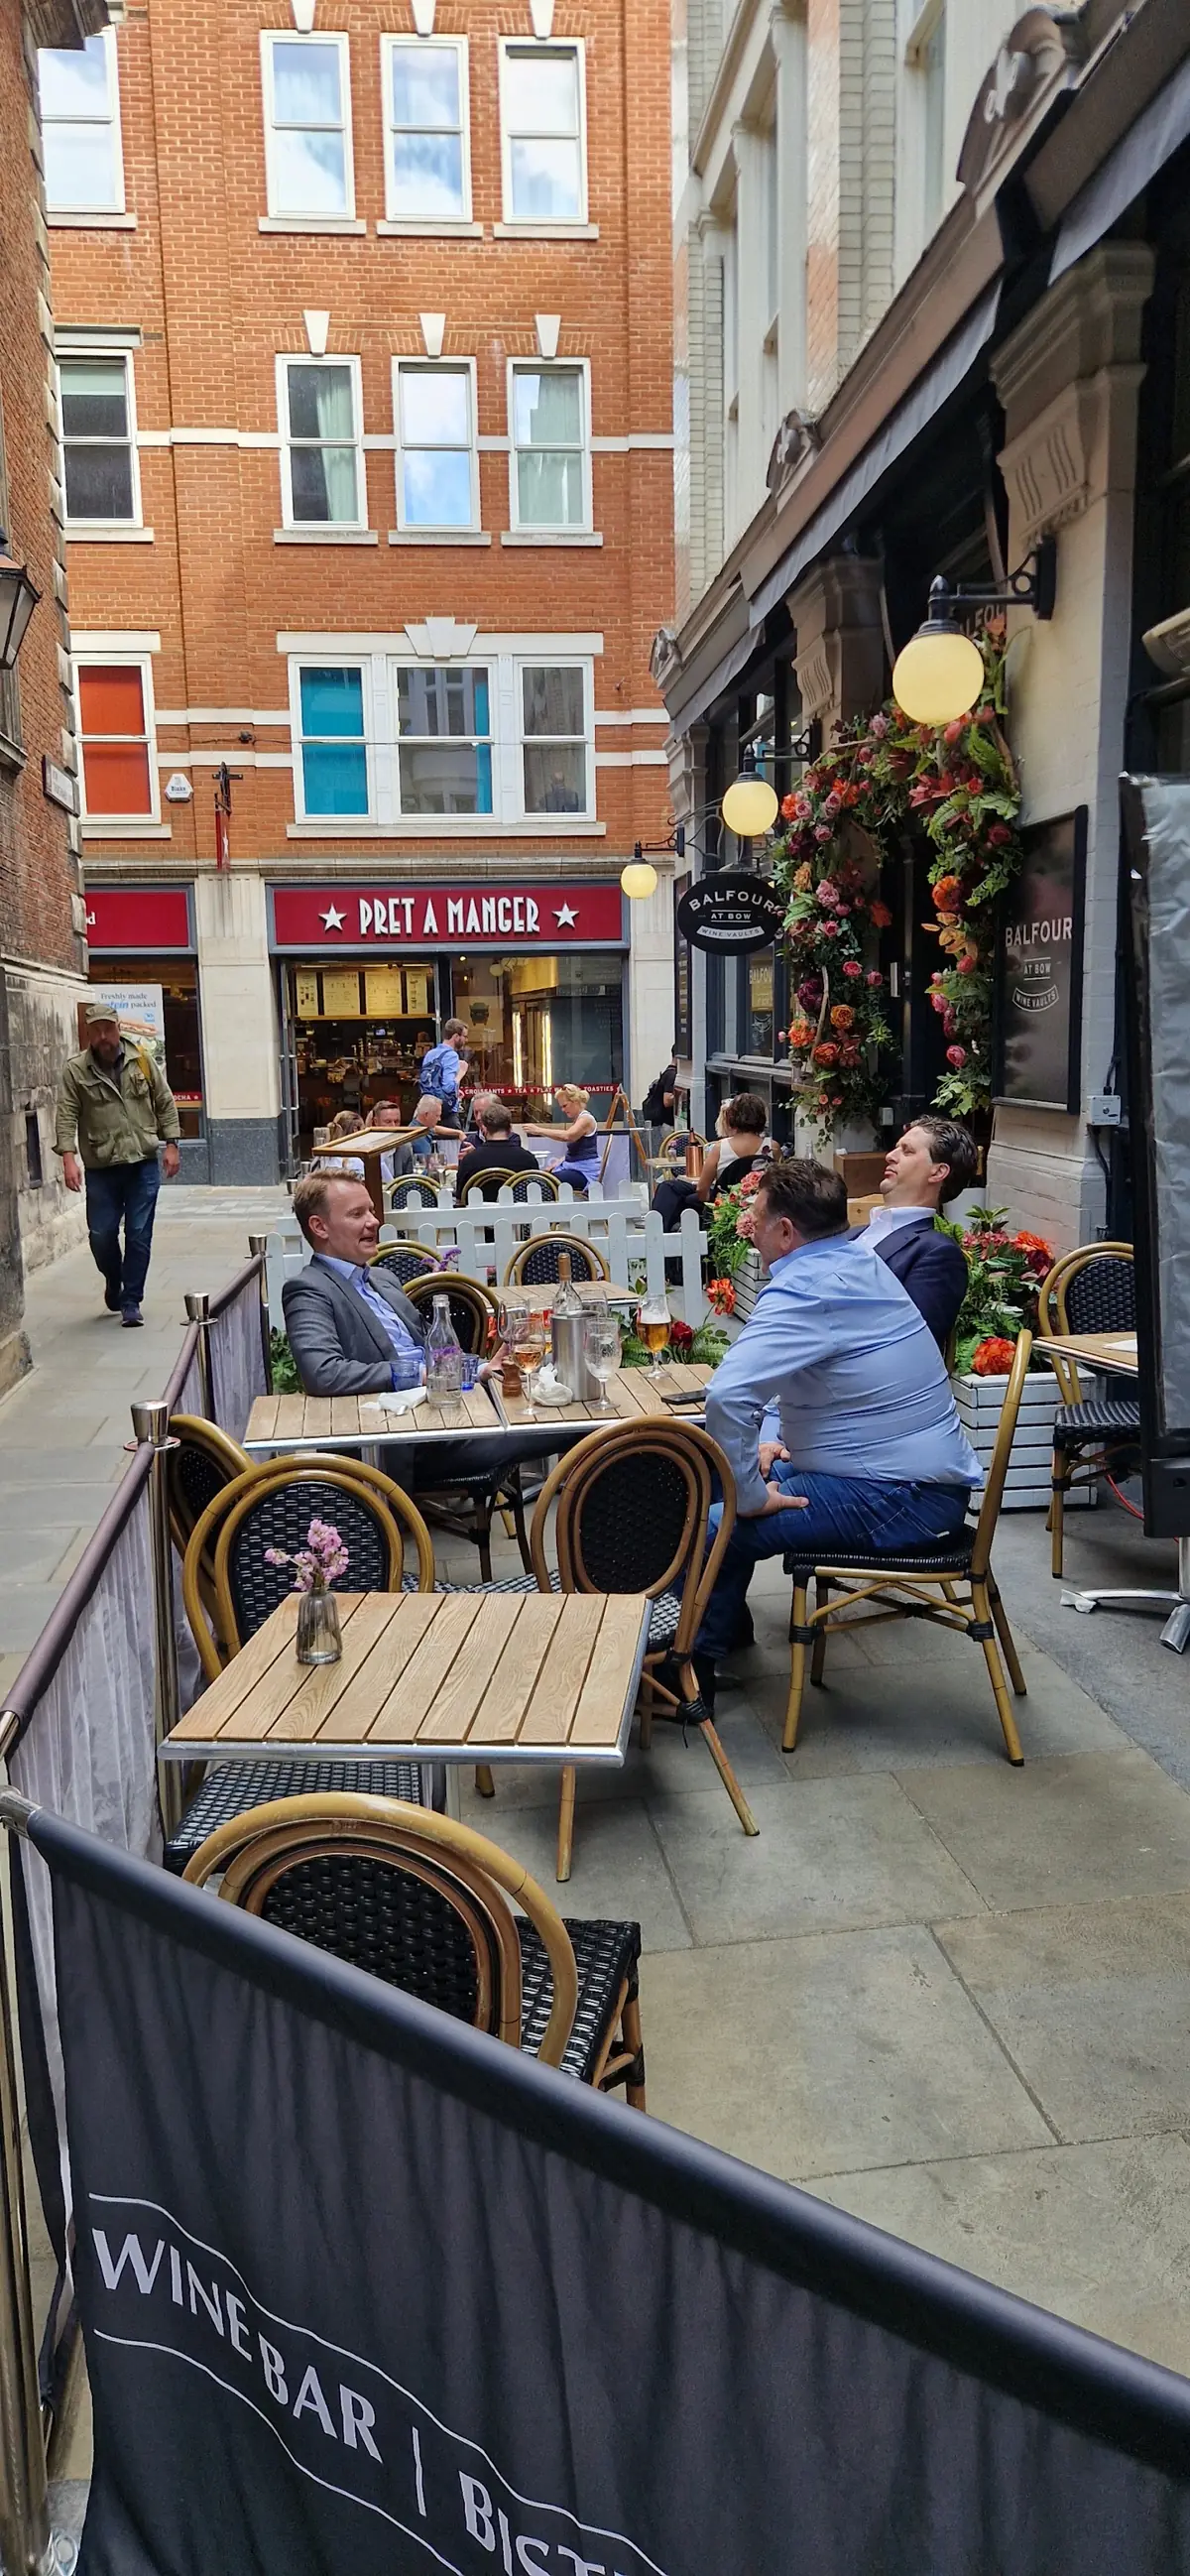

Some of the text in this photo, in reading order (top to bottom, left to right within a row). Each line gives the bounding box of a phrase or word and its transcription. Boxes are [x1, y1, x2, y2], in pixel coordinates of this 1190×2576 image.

[688, 890, 774, 912] BALFOUR
[359, 897, 540, 935] PRET A MANGER
[701, 928, 760, 937] WINE VAULTS
[1005, 917, 1073, 948] BALFOUR
[1023, 963, 1051, 975] AT BOW
[131, 1001, 157, 1010] packed
[1015, 990, 1056, 1008] WINE VAULTS
[91, 2227, 253, 2363] WINE
[258, 2331, 384, 2464] BAR
